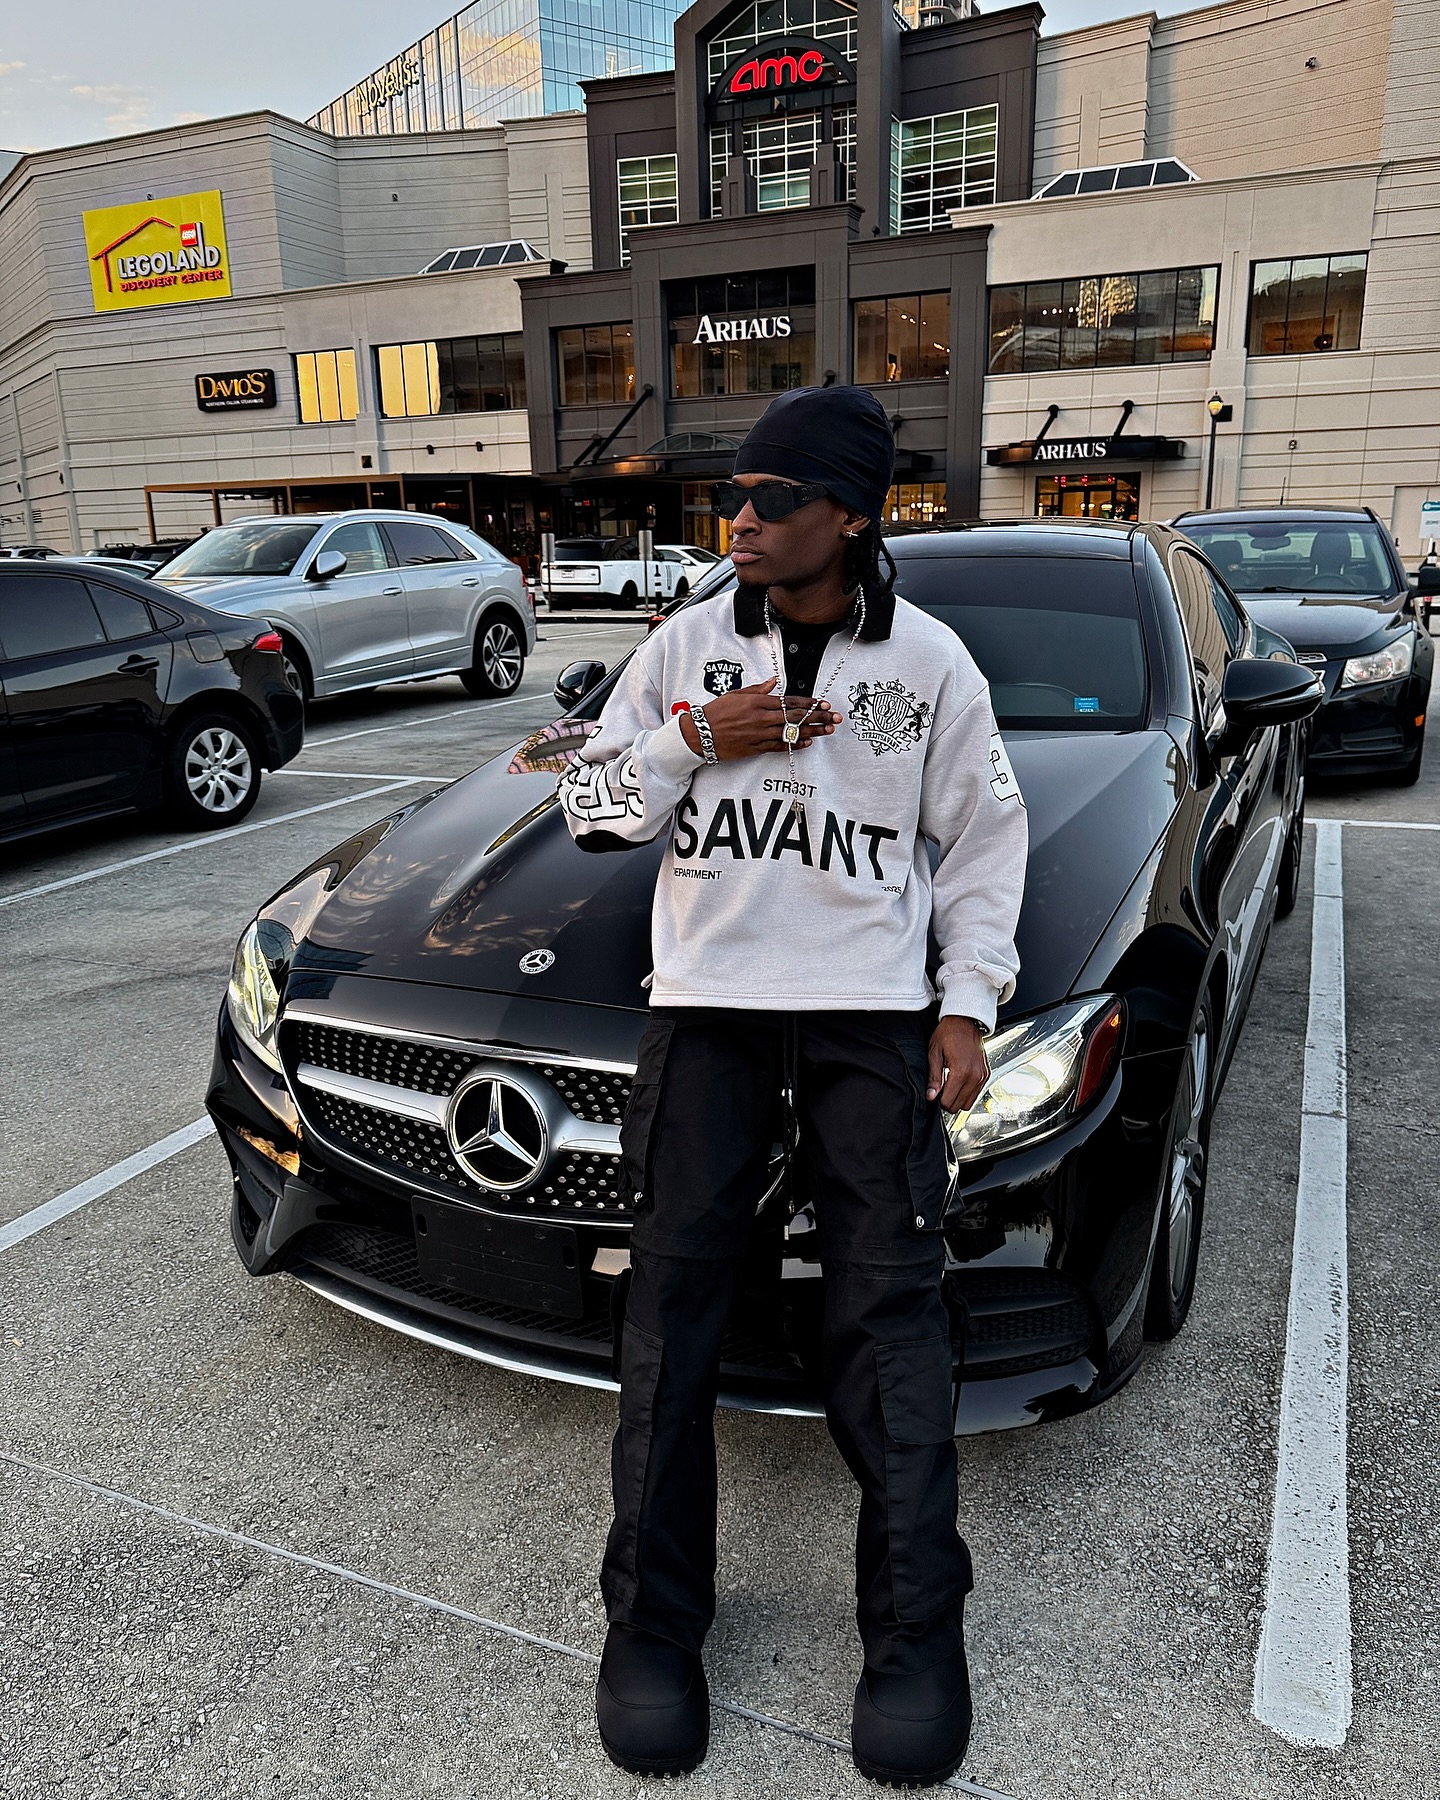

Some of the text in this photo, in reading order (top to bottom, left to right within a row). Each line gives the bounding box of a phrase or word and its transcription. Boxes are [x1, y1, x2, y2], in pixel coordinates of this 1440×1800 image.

[731, 51, 823, 93] amc
[117, 222, 220, 279] LEGOLAND
[120, 269, 223, 292] DISCOVERY CENTER
[692, 315, 791, 344] ARHAUS
[1034, 442, 1106, 460] ARHAUS
[706, 663, 741, 674] SAVANT
[763, 779, 817, 798] STR33T
[674, 796, 899, 881] SAVANT
[673, 867, 722, 880] EPARTMENT
